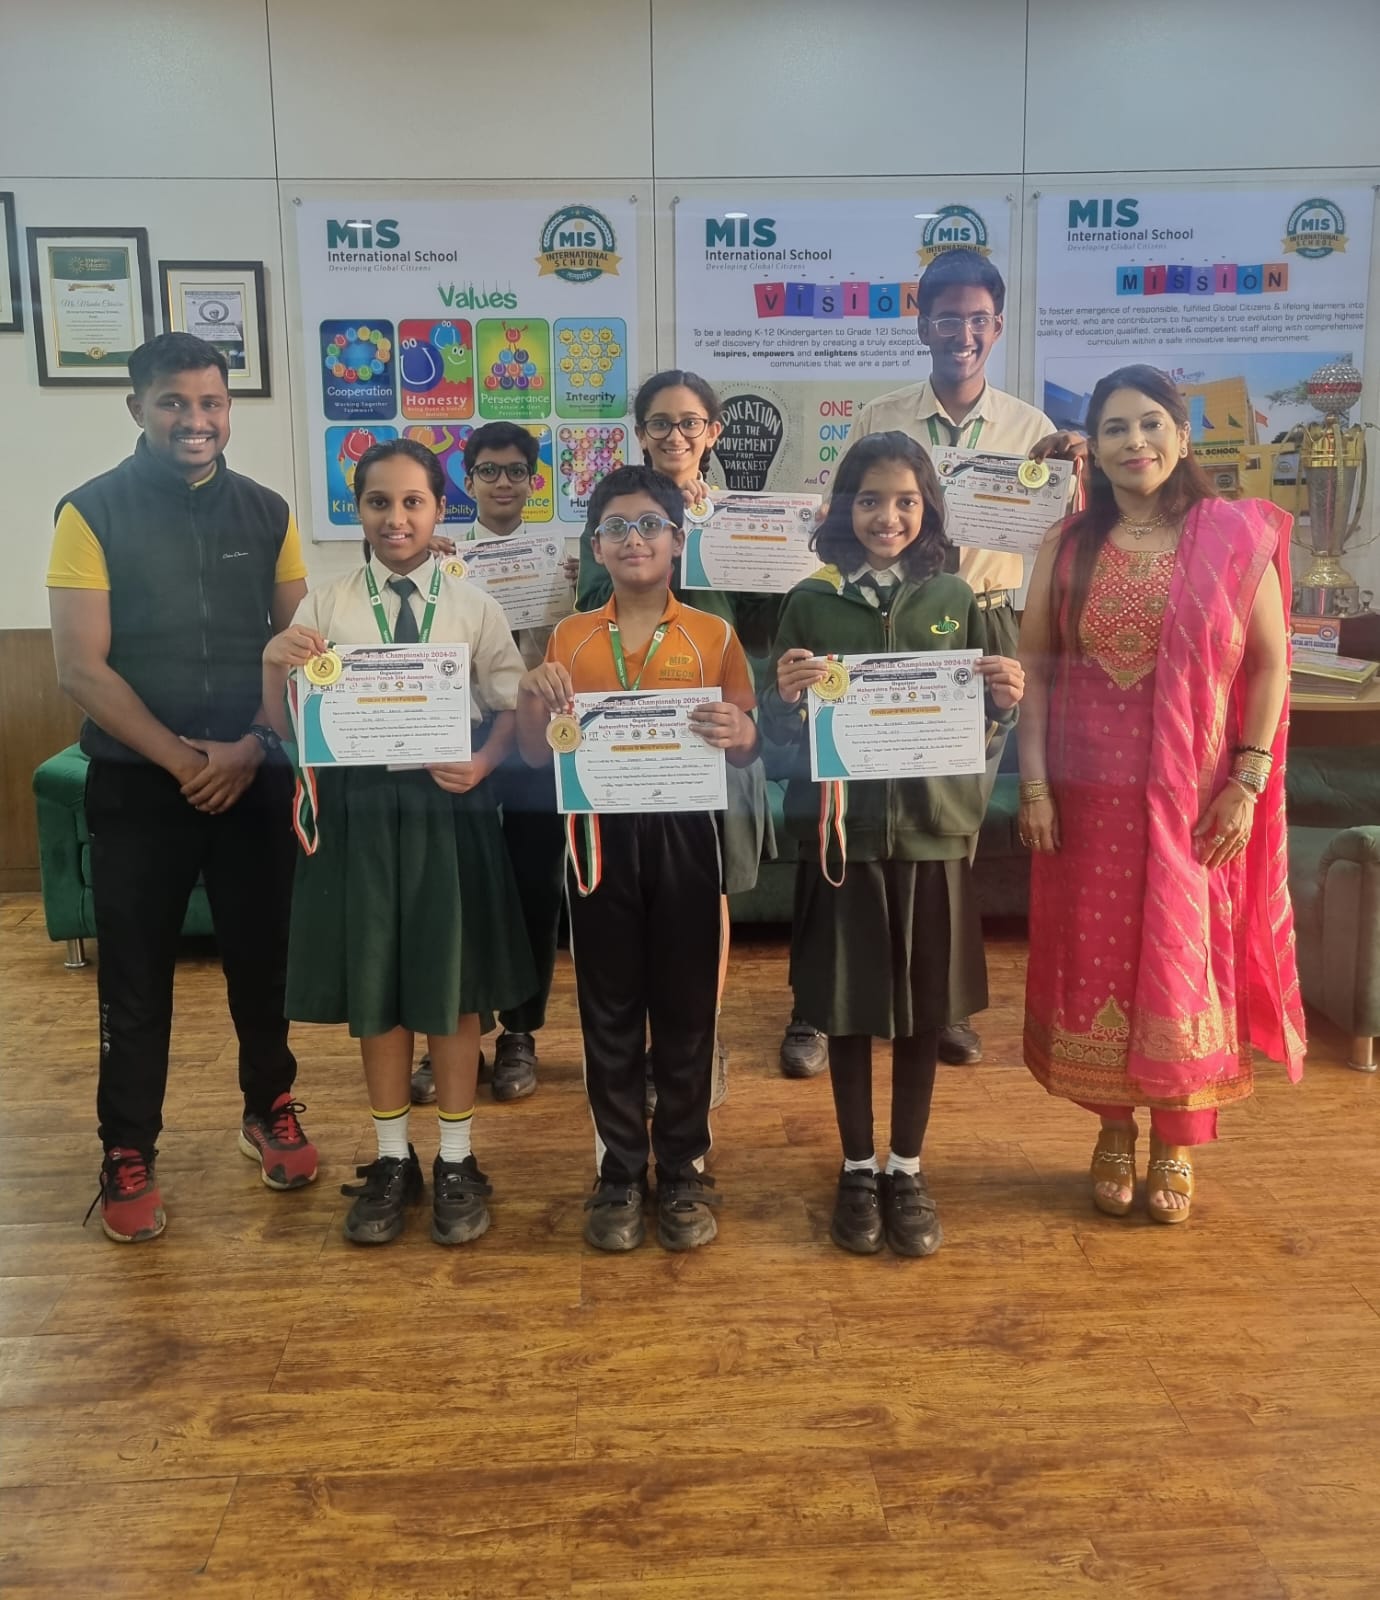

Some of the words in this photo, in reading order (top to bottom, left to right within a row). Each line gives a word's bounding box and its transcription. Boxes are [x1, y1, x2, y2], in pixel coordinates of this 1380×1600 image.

[1068, 198, 1139, 228] MIS
[1301, 218, 1330, 231] MIS
[327, 219, 400, 249] MIS
[705, 218, 777, 247] MIS
[939, 227, 971, 241] MIS
[1067, 229, 1148, 242] International
[1152, 228, 1193, 240] School
[559, 232, 596, 247] MIS
[328, 250, 411, 262] International
[414, 250, 457, 262] School
[546, 251, 608, 261] INTERNATIONAL
[705, 249, 786, 260] International
[789, 248, 832, 260] School
[329, 264, 372, 272] Developing
[374, 264, 398, 272] Global
[401, 264, 431, 272] Citizens
[554, 259, 600, 267] SCHOOL
[706, 263, 747, 271] Developing
[775, 262, 805, 270] Citizens
[1123, 271, 1282, 291] MISSION
[438, 284, 517, 310] Values
[1049, 307, 1072, 315] foster
[1076, 307, 1120, 315] emergence
[1213, 304, 1237, 312] Global
[1240, 303, 1271, 312] Citizens
[1274, 303, 1280, 311] &
[1283, 302, 1310, 311] lifelong
[1313, 302, 1345, 310] learners
[1083, 317, 1099, 325] who
[1117, 316, 1167, 324] contributors
[1170, 315, 1179, 323] to
[1228, 314, 1245, 322] true
[1247, 313, 1281, 322] evolution
[1284, 313, 1294, 322] by
[1296, 312, 1332, 322] providing
[1334, 312, 1364, 321] highest
[693, 328, 702, 337] To
[704, 328, 714, 336] be
[724, 328, 752, 338] leading
[754, 328, 775, 336] K-12
[835, 328, 845, 336] to
[847, 328, 872, 336] Grade
[1037, 328, 1063, 337] quality
[1065, 328, 1074, 336] of
[1194, 324, 1237, 334] competent
[1240, 324, 1259, 332] staff
[1261, 323, 1283, 333] along
[1285, 323, 1302, 331] with
[1304, 322, 1363, 332] comprehensive
[694, 339, 702, 347] of
[705, 339, 720, 347] self
[722, 339, 760, 348] discovery
[762, 339, 773, 347] for
[776, 338, 809, 347] children
[811, 338, 820, 347] by
[823, 339, 856, 348] creating
[867, 339, 886, 348] truly
[1087, 338, 1130, 346] curriculum
[1132, 337, 1156, 345] within
[1166, 336, 1183, 344] safe
[1185, 336, 1224, 344] innovative
[1227, 335, 1258, 344] learning
[713, 350, 750, 359] inspires,
[752, 350, 795, 359] empowers
[797, 349, 812, 357] and
[814, 349, 858, 358] enlightens
[860, 349, 898, 357] students
[900, 349, 915, 357] and
[770, 360, 822, 368] communities
[823, 360, 842, 368] that
[882, 360, 899, 368] part
[327, 385, 392, 398] Cooperation
[406, 395, 467, 407] Honesty
[481, 393, 550, 405] Perseverance
[566, 392, 616, 404] Integrity
[820, 400, 853, 416] ONE
[721, 400, 780, 436] DUCATION
[732, 424, 740, 434] IS
[746, 425, 760, 436] THE
[717, 437, 776, 452] MOVEMENT
[1205, 447, 1240, 456] SCHOOL
[724, 460, 767, 471] DARKNESS
[386, 652, 430, 660] Championship
[897, 661, 942, 669] Championship
[638, 699, 681, 707] Championship
